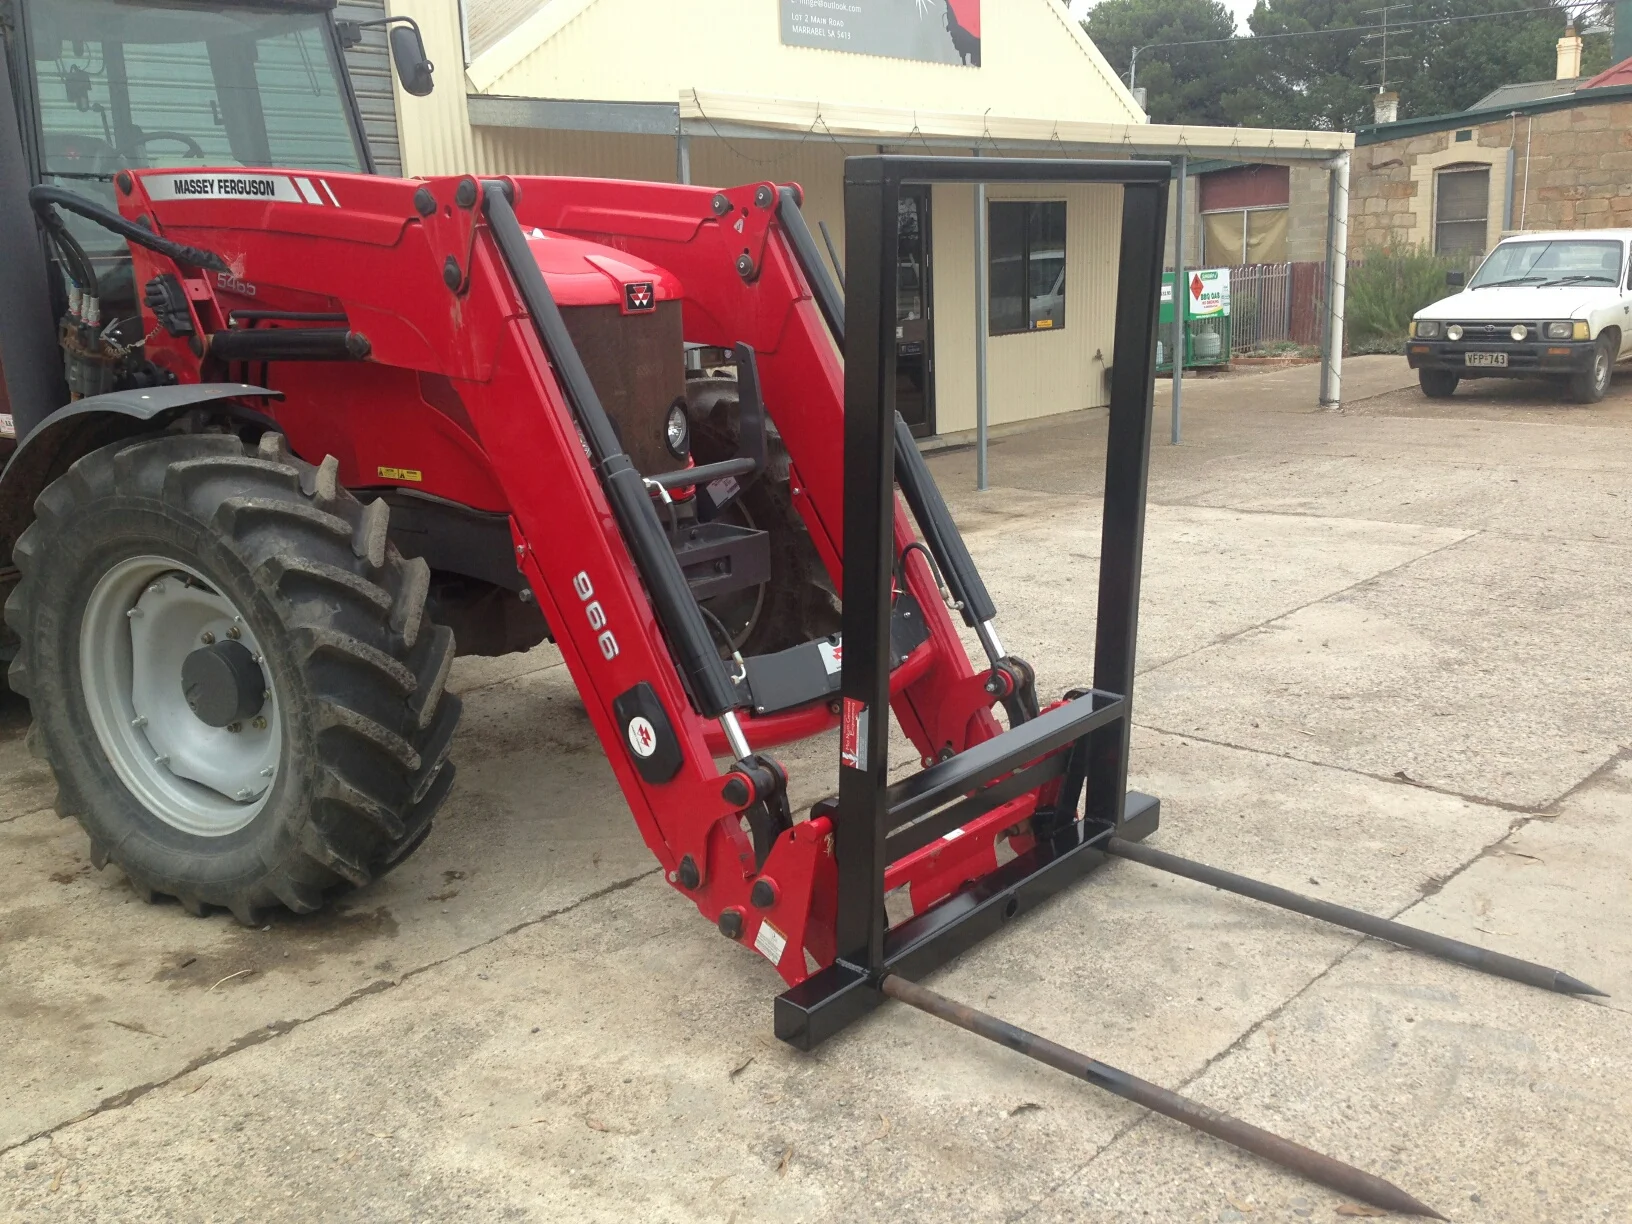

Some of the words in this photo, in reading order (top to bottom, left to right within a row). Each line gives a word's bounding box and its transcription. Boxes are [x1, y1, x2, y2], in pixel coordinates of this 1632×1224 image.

[804, 14, 809, 23] 2
[792, 25, 826, 37] MARRABEL
[827, 29, 836, 38] SA
[173, 179, 215, 195] MASSEY
[217, 179, 276, 196] FERGUSON
[573, 570, 620, 661] 966
